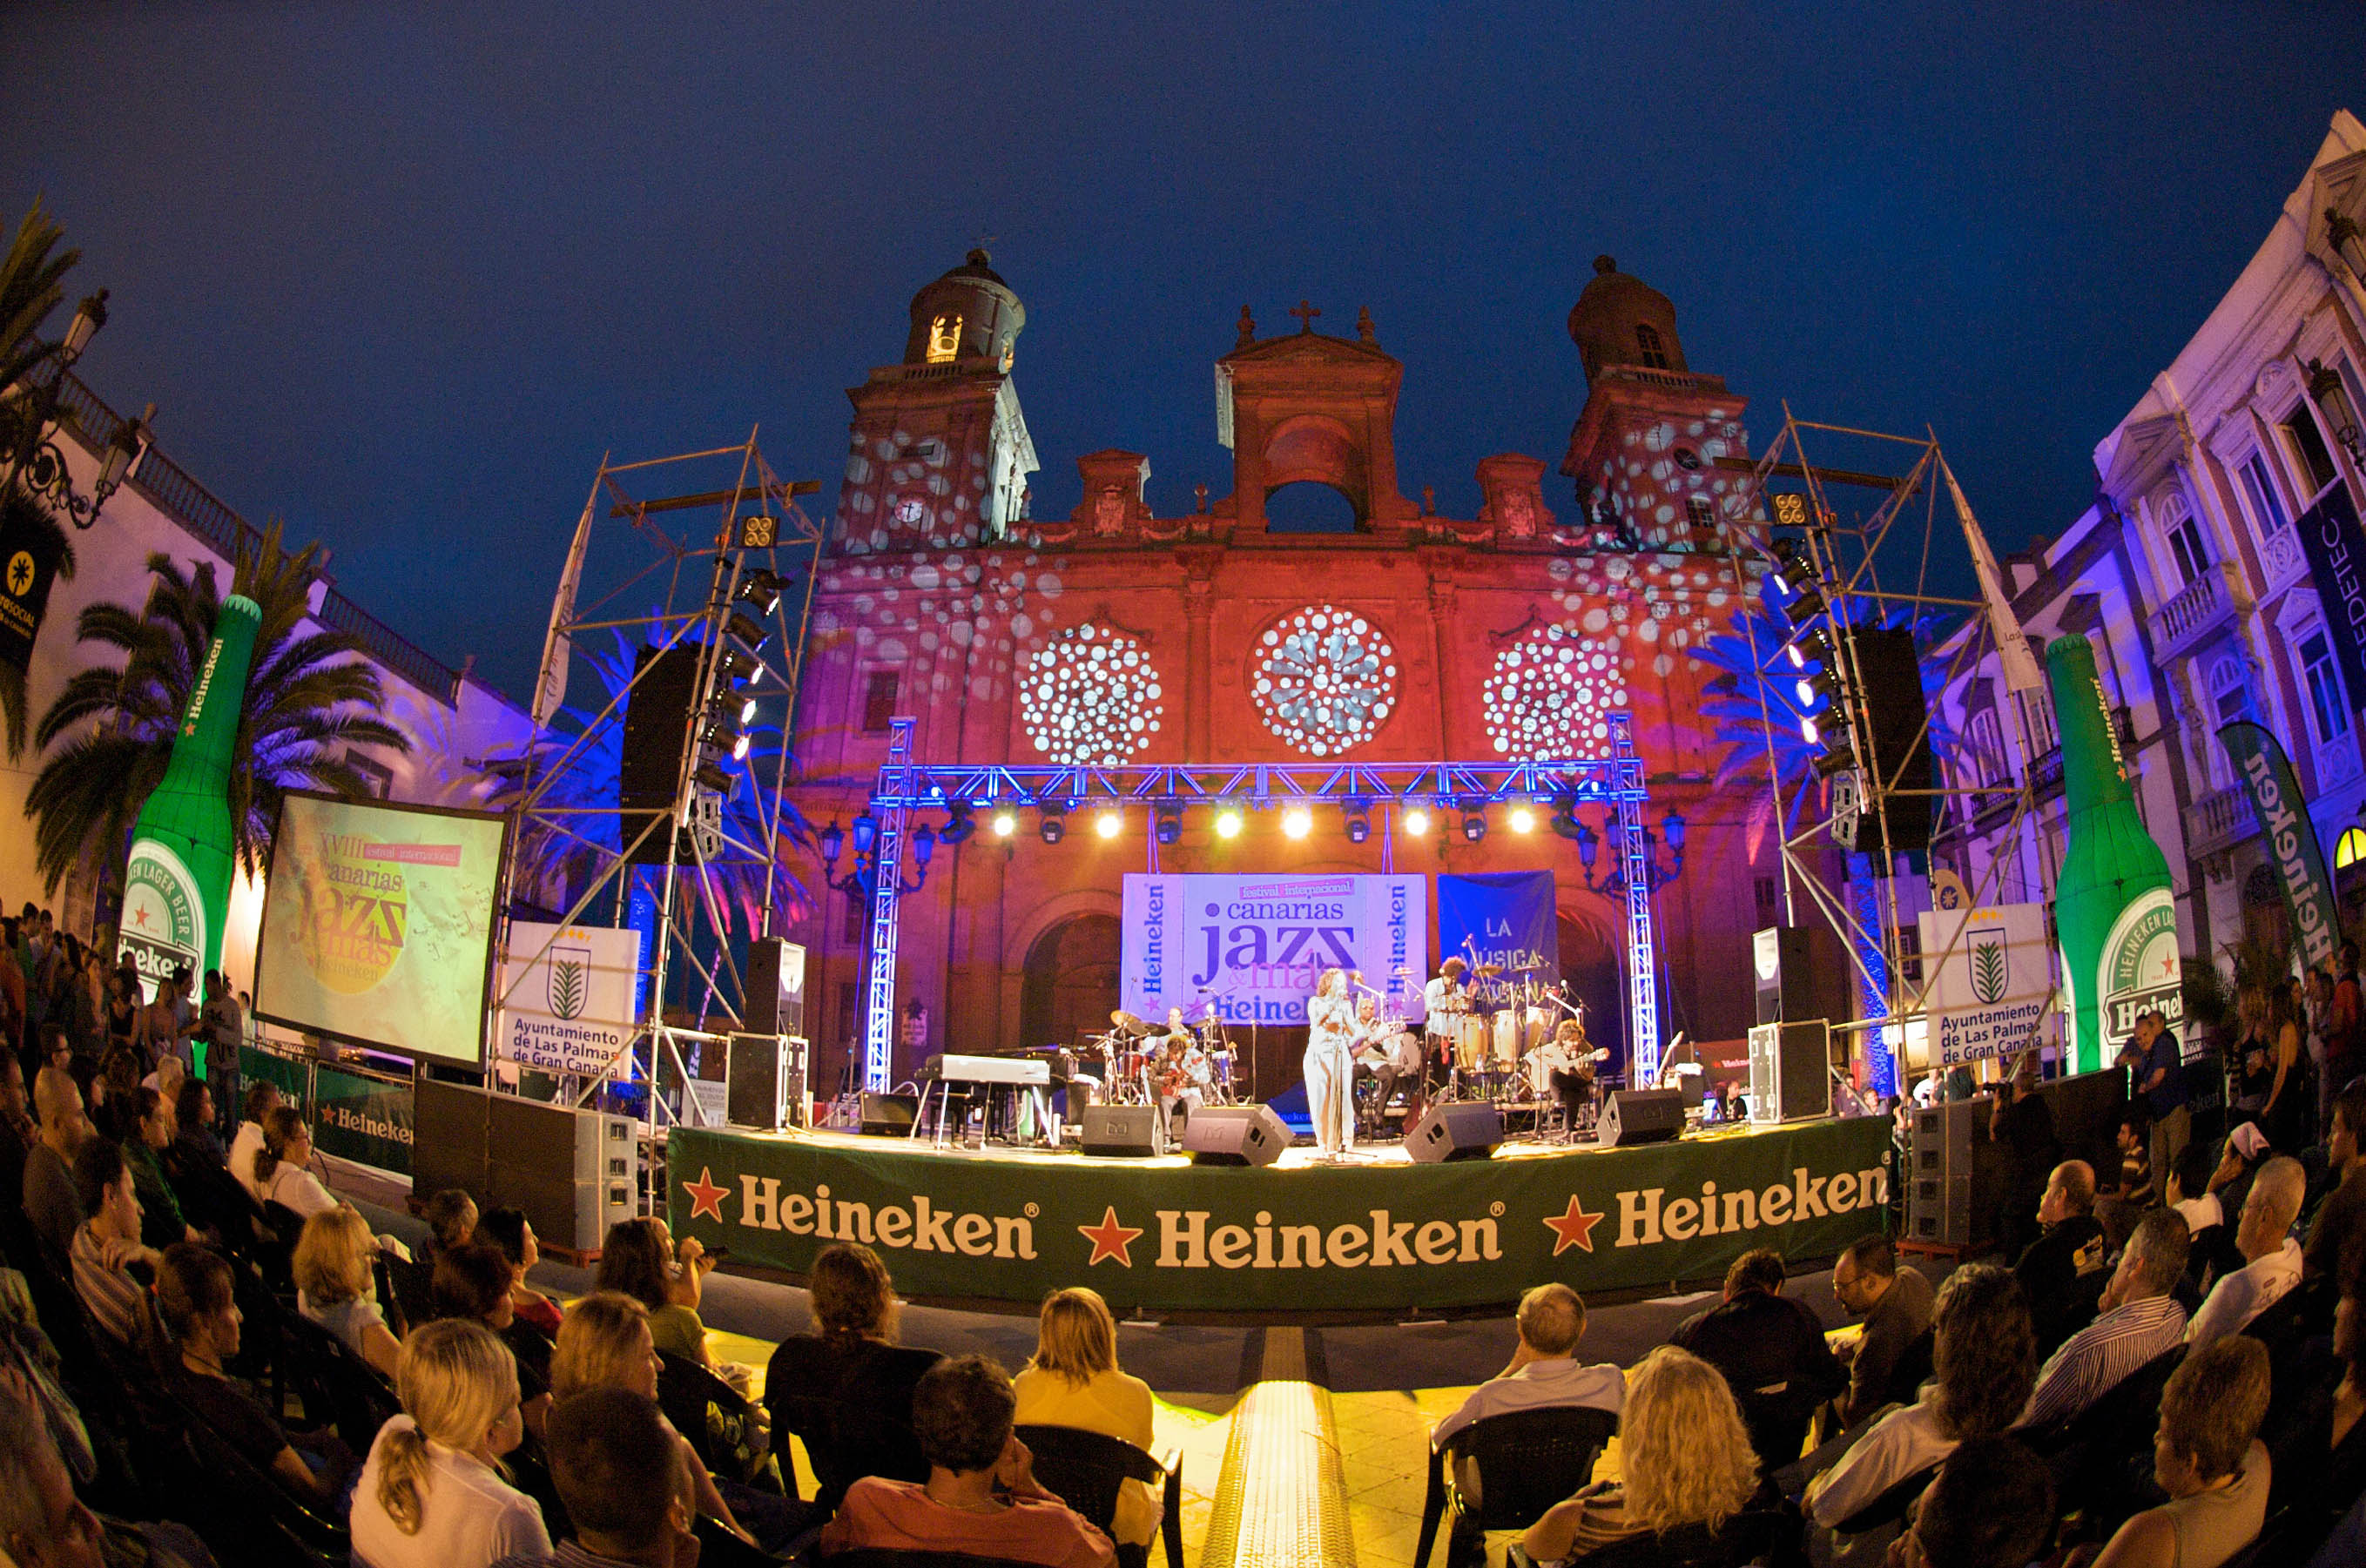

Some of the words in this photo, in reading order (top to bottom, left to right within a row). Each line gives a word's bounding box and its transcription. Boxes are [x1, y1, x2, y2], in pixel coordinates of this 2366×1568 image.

[189, 637, 224, 720] Heineken
[2093, 679, 2122, 763] Heineken
[145, 863, 176, 897] LAGER
[172, 895, 191, 935] BEER
[1227, 896, 1344, 919] canarias
[1244, 885, 1279, 898] festival
[1143, 885, 1163, 994] Heineken
[1192, 903, 1357, 986] jazz
[1486, 917, 1513, 937] LA
[2120, 912, 2161, 978] HEINEKEN
[515, 1018, 619, 1046] Ayuntamiento
[1941, 1004, 2039, 1033] Ayuntamiento
[1941, 1033, 1960, 1048] de
[1965, 1030, 1988, 1044] Las
[513, 1033, 530, 1048] de
[535, 1037, 558, 1053] Las
[513, 1048, 529, 1063] de
[532, 1052, 562, 1069] Gran
[1943, 1049, 1959, 1064] de
[1964, 1045, 1994, 1060] Gran
[738, 1173, 1038, 1261] Heineken
[1615, 1165, 1890, 1248] Heineken
[1155, 1209, 1504, 1269] Heineken
